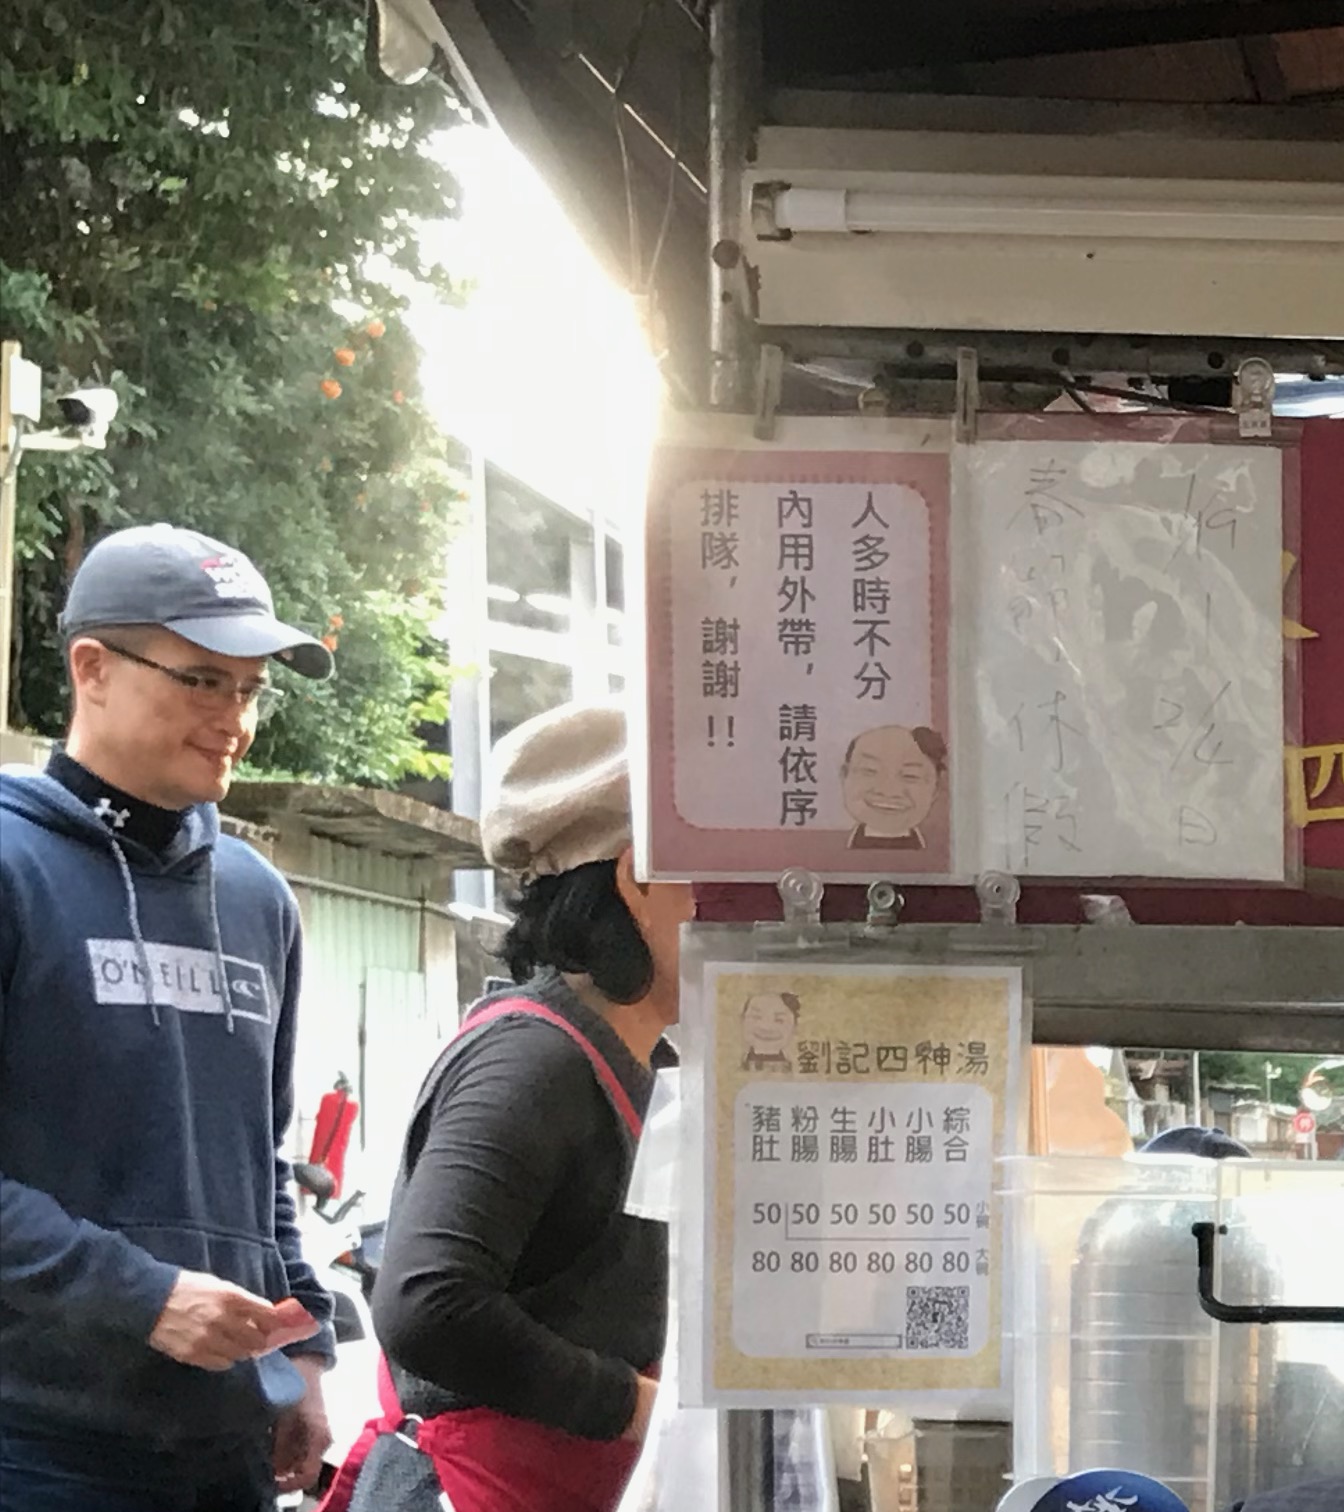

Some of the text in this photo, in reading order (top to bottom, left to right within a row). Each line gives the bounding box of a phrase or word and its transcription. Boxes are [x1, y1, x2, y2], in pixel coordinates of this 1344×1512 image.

[851, 491, 892, 700] 人多時不分
[798, 1040, 990, 1076] 劉記四神湯
[751, 1105, 781, 1163] 豬肚
[791, 1105, 820, 1163] 粉腸
[829, 1105, 858, 1163] 生腸
[867, 1105, 896, 1163] 小肚
[905, 1105, 934, 1163] 小腸
[943, 1105, 971, 1163] 綜合
[751, 1202, 971, 1225] 50 50 50 50 50 50
[751, 1250, 970, 1274] 80 80 80 80 80 80
